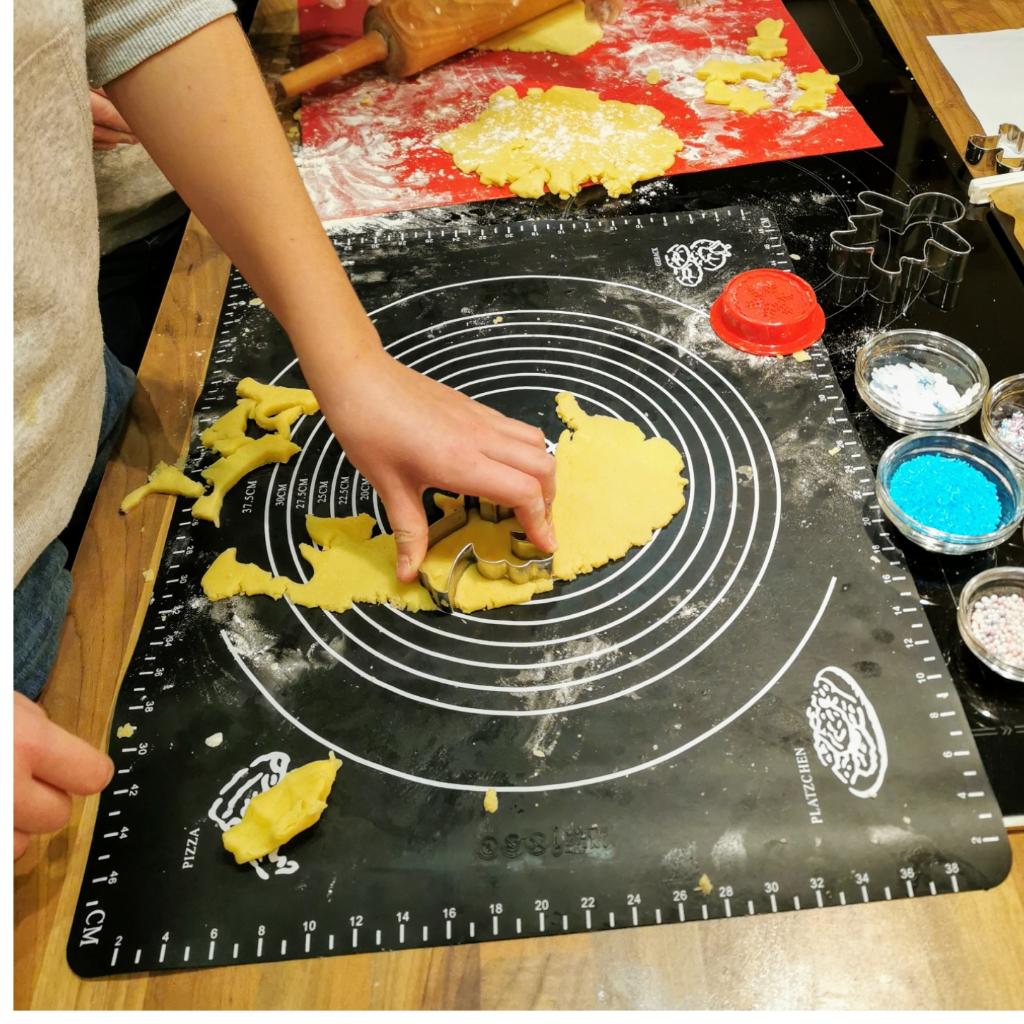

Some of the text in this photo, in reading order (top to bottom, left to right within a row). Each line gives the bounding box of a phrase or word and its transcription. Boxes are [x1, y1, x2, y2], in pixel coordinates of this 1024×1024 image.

[241, 479, 258, 514] 37.5CM
[275, 483, 288, 507] 30CM
[295, 478, 309, 510] 27.5CM
[317, 480, 329, 503] 25CM
[338, 476, 350, 505] 22.5CM
[154, 667, 165, 677] 36
[862, 517, 872, 527] 20
[872, 544, 881, 554] 18
[882, 573, 892, 584] 16
[892, 605, 902, 616] 14
[903, 637, 914, 649] 12
[915, 672, 927, 684] 10
[929, 711, 940, 720] 8
[943, 750, 953, 759] 6
[957, 791, 967, 799] 4
[971, 835, 983, 845] 2
[144, 700, 155, 713] 38
[137, 742, 149, 755] 30
[128, 783, 139, 796] 42
[794, 747, 823, 824] PLATZCHEN
[118, 826, 130, 840] 44
[182, 827, 201, 870] PIZZA
[107, 870, 119, 885] 46
[114, 863, 960, 946] 2 4 6 8 10 12 14 16 18 20 22 24 26 28 30 32 34 36 38
[79, 909, 106, 947] CM
